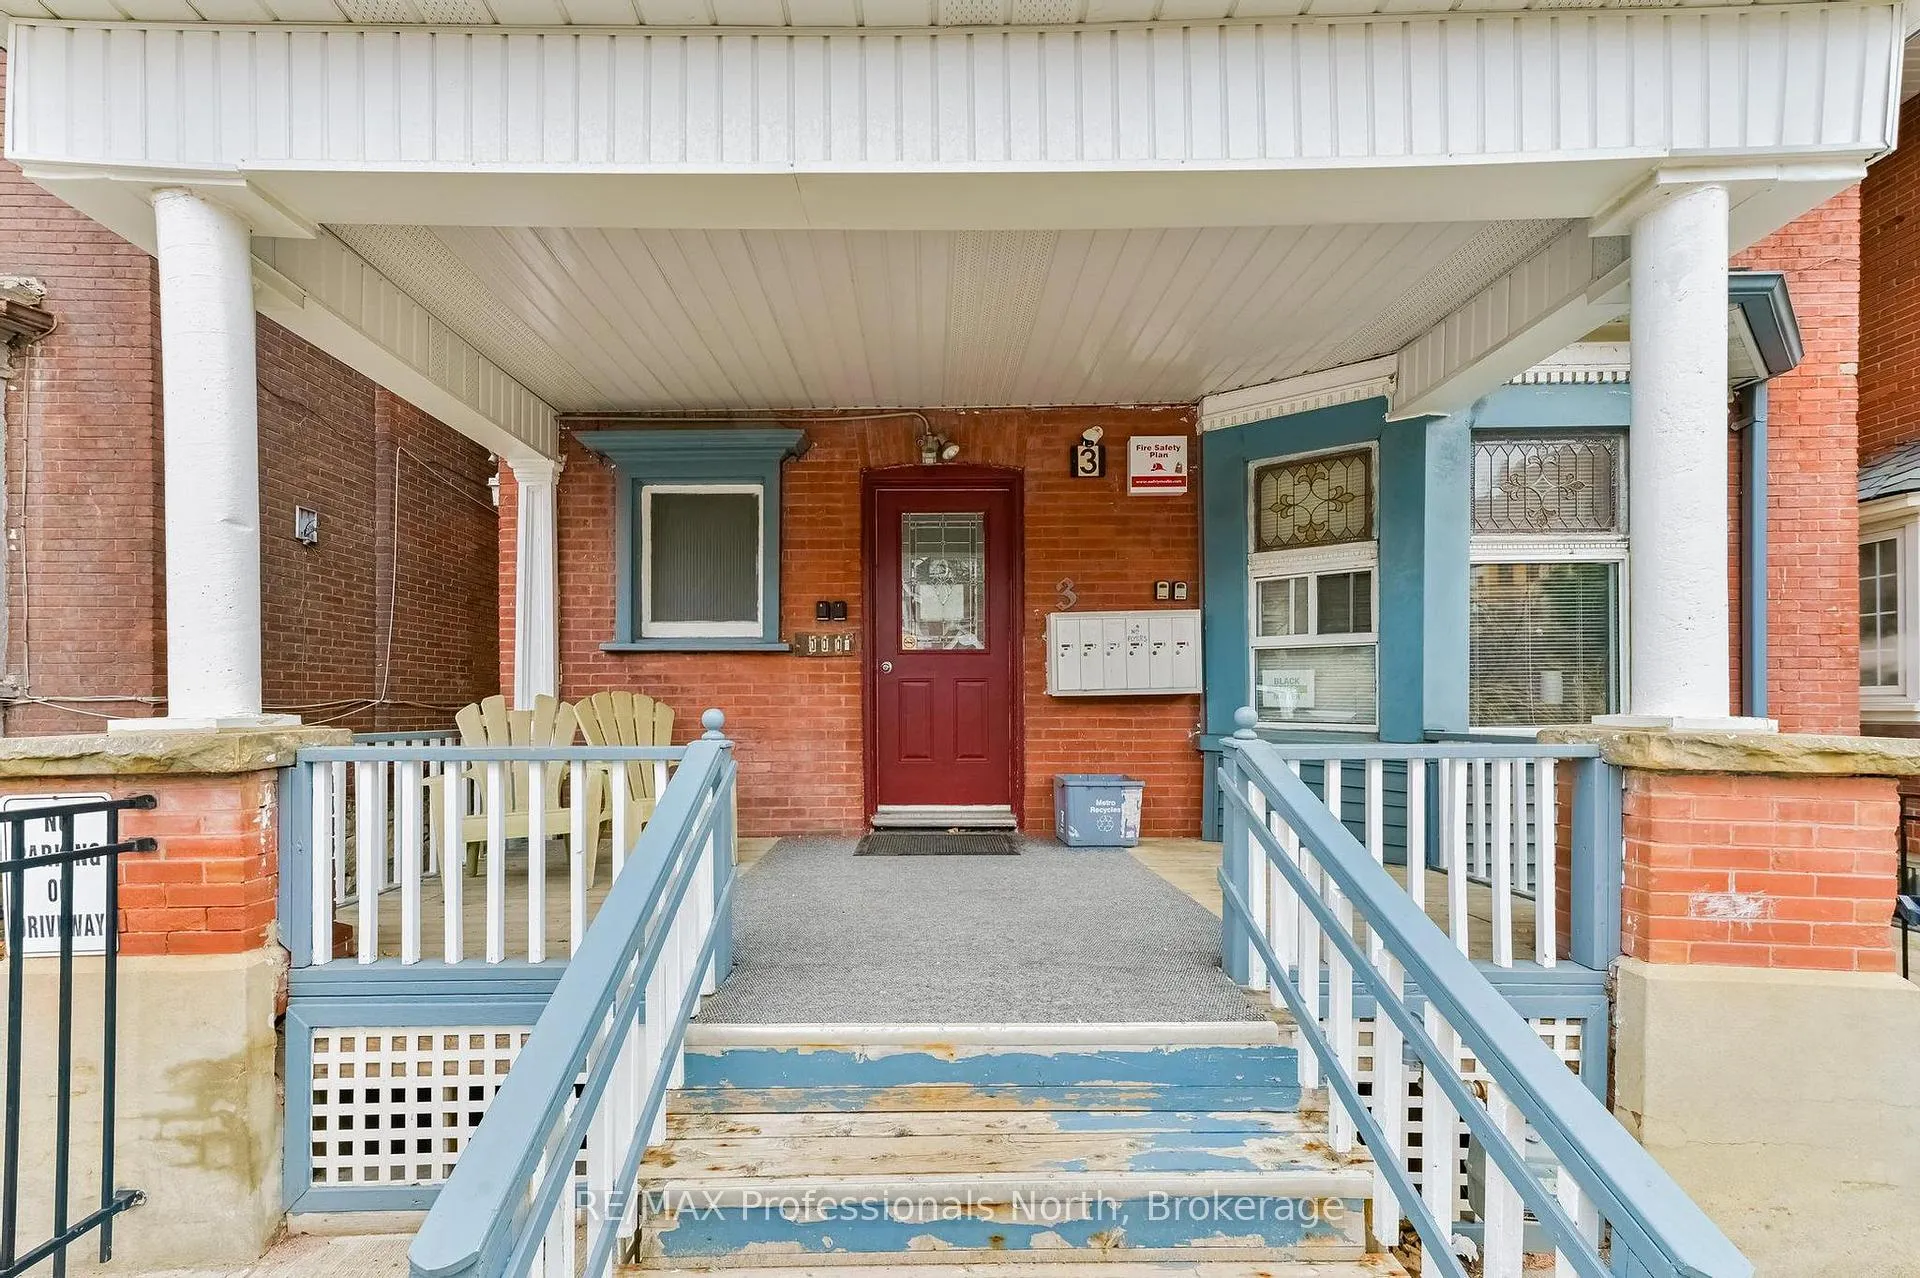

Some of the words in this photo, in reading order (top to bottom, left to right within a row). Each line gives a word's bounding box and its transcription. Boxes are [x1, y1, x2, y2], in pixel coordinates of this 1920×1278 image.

[1154, 444, 1181, 452] Safety
[1080, 448, 1097, 474] 3
[1055, 577, 1077, 611] 3
[1273, 677, 1300, 685] BLACK
[19, 914, 105, 938] RIVWAY
